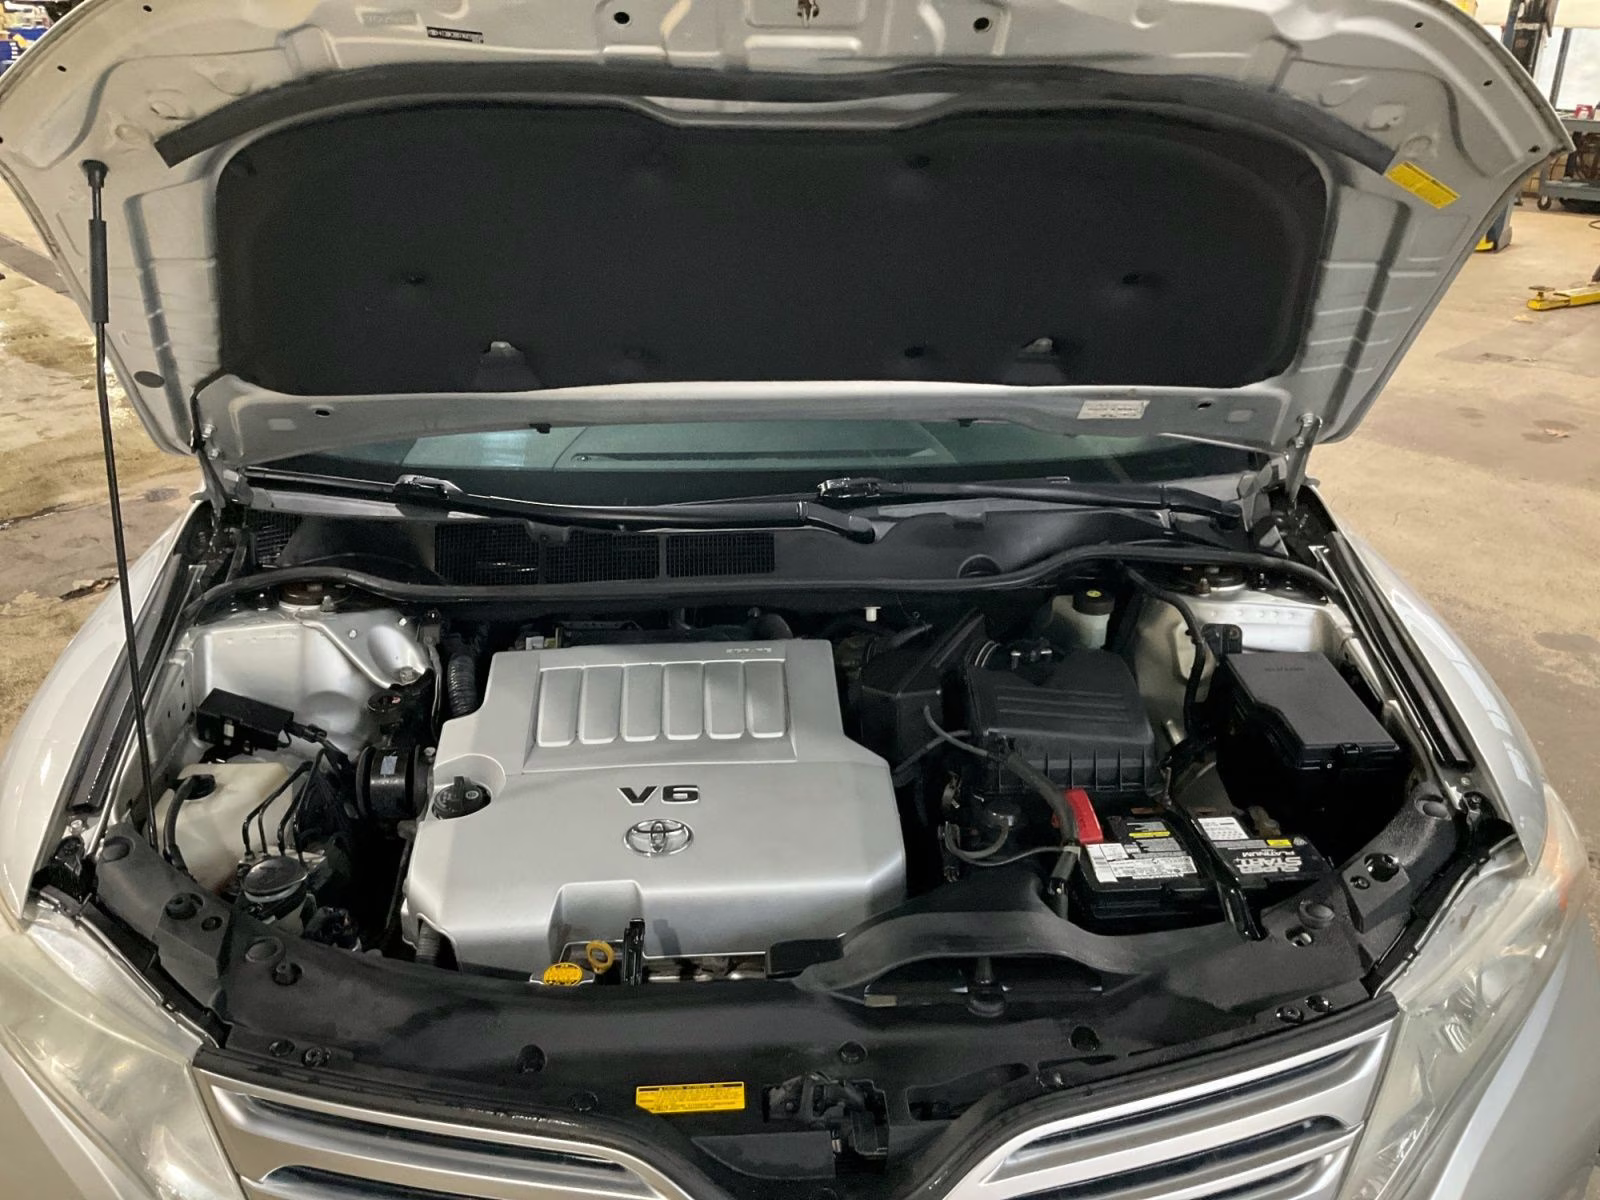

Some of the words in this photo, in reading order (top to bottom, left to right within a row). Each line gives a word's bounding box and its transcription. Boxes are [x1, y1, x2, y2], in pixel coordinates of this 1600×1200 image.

[617, 784, 699, 805] V6
[1237, 856, 1302, 867] START
[1239, 864, 1299, 874] SUPER
